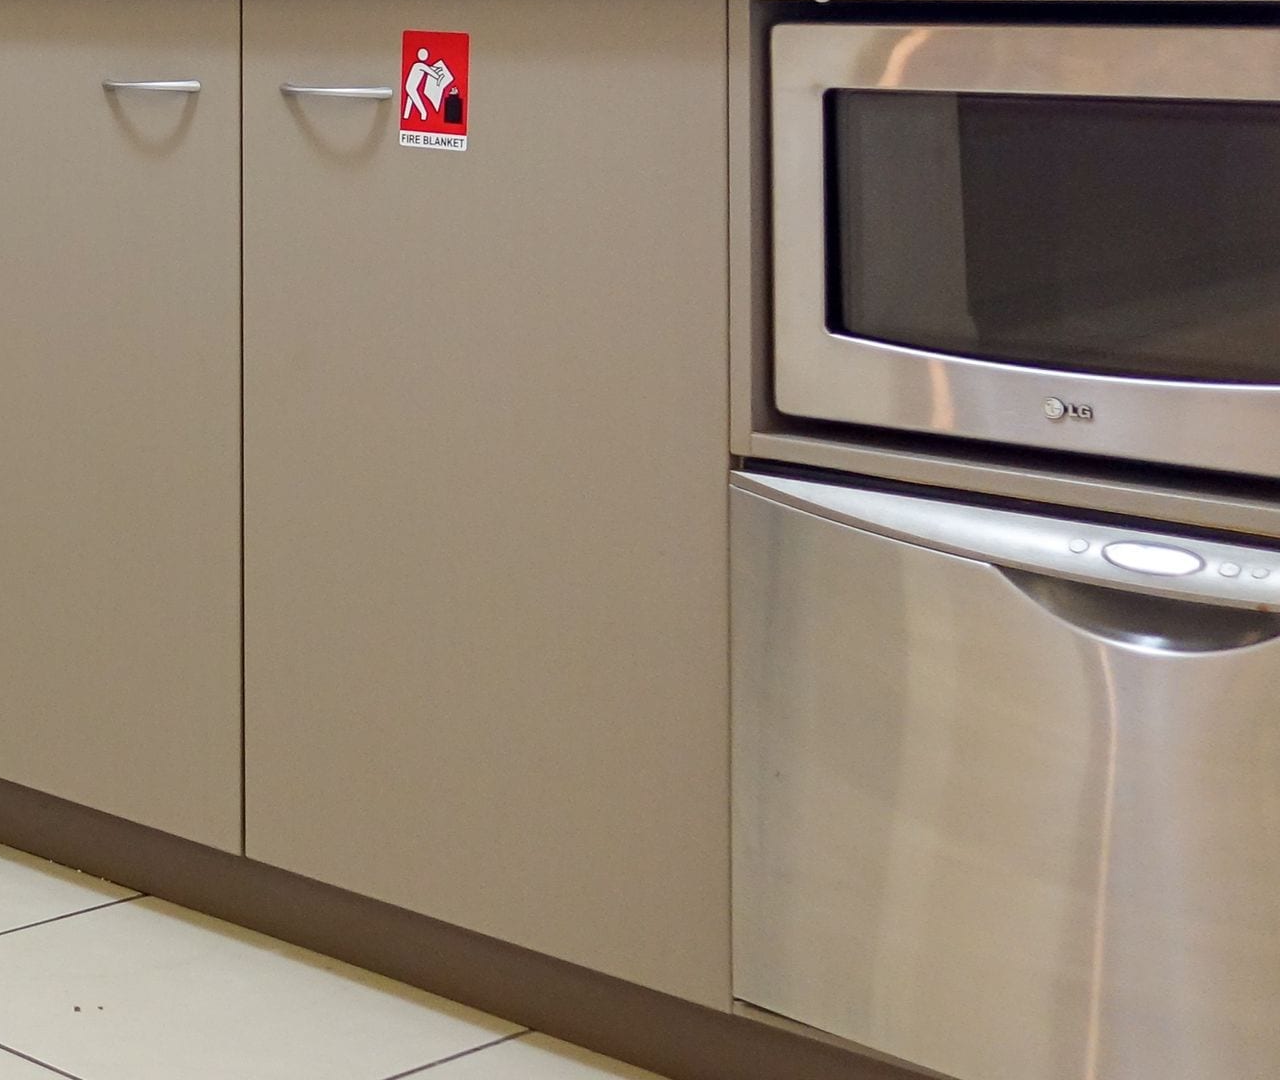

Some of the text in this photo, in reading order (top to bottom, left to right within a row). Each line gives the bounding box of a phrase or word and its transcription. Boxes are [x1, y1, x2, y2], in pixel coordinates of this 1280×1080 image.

[401, 133, 465, 148] FIRE BLANKET
[1067, 403, 1093, 419] LG
